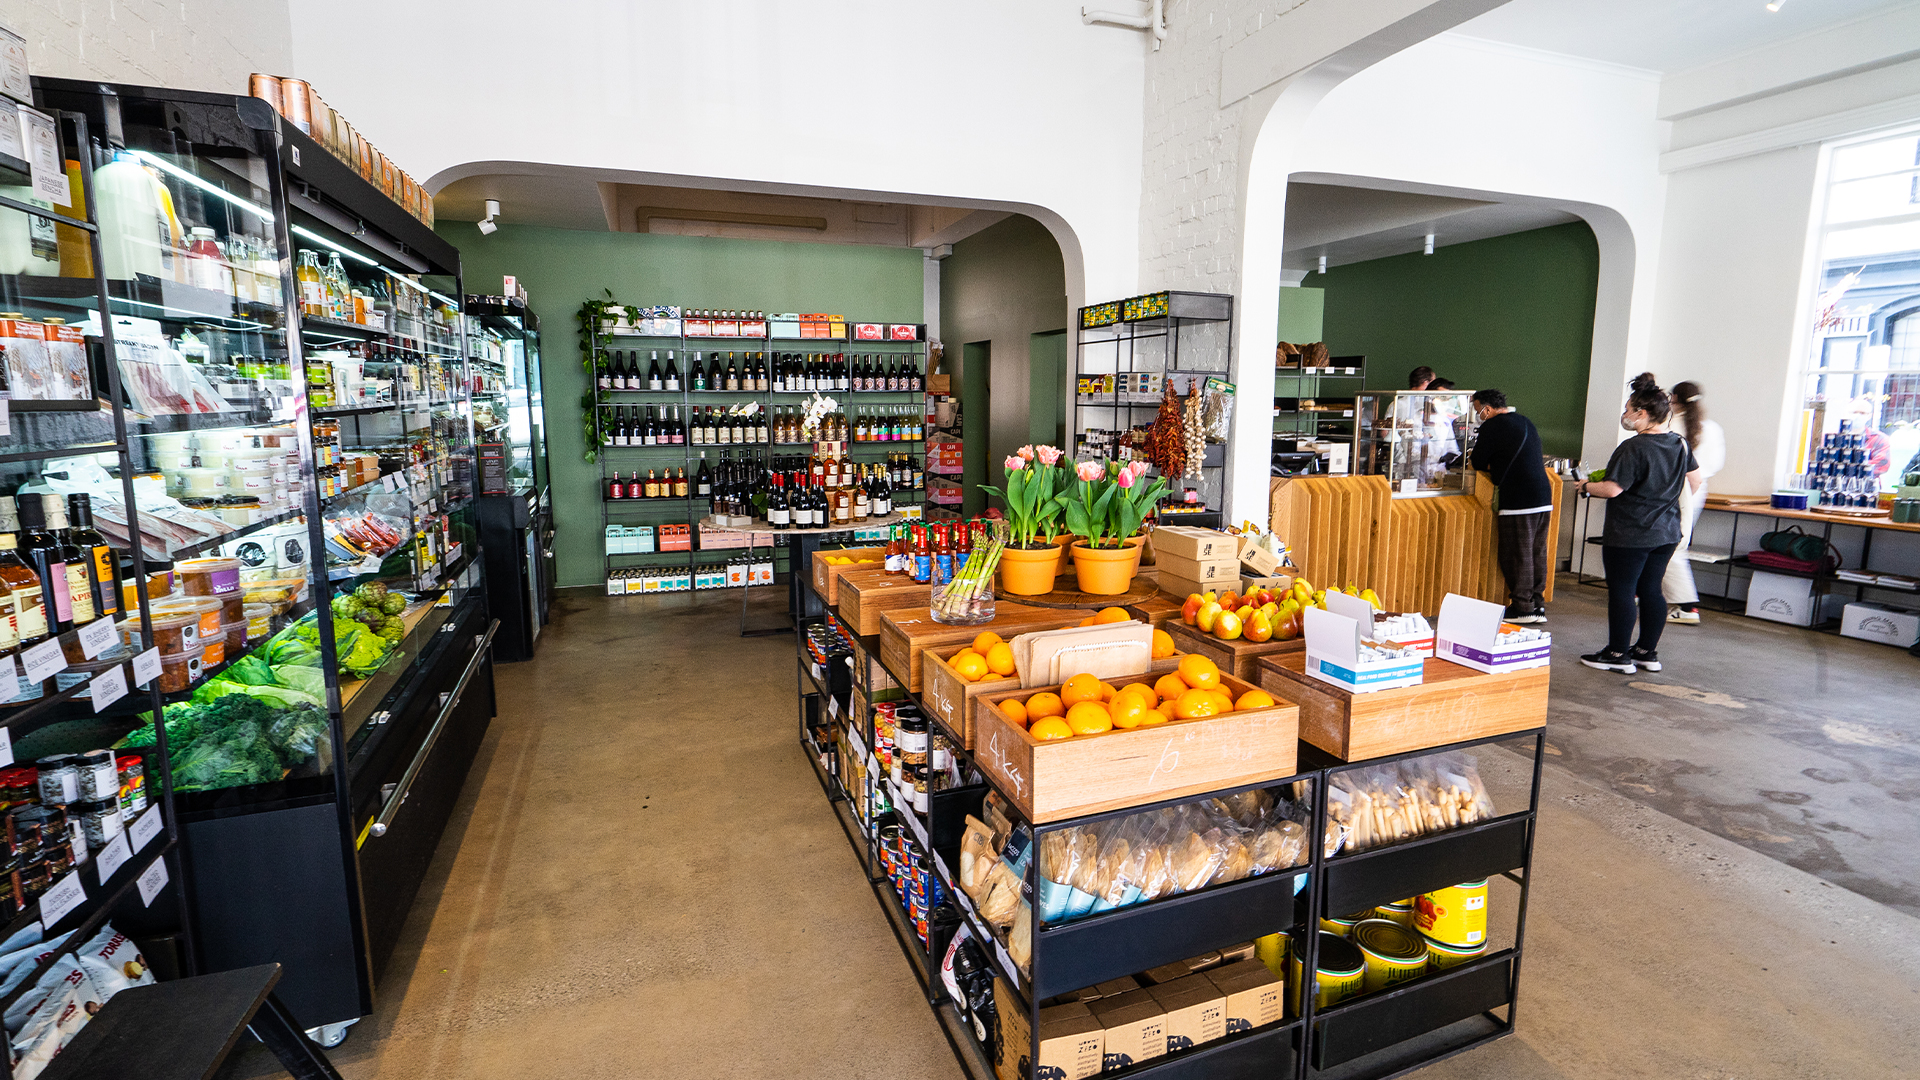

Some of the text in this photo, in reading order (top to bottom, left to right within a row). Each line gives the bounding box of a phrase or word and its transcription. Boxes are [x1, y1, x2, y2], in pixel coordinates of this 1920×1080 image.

[41, 183, 62, 194] SENCHA
[39, 649, 59, 663] VINEGAR
[1149, 738, 1179, 786] 6
[98, 932, 127, 960] TORRE
[1387, 966, 1425, 979] JULIETTE
